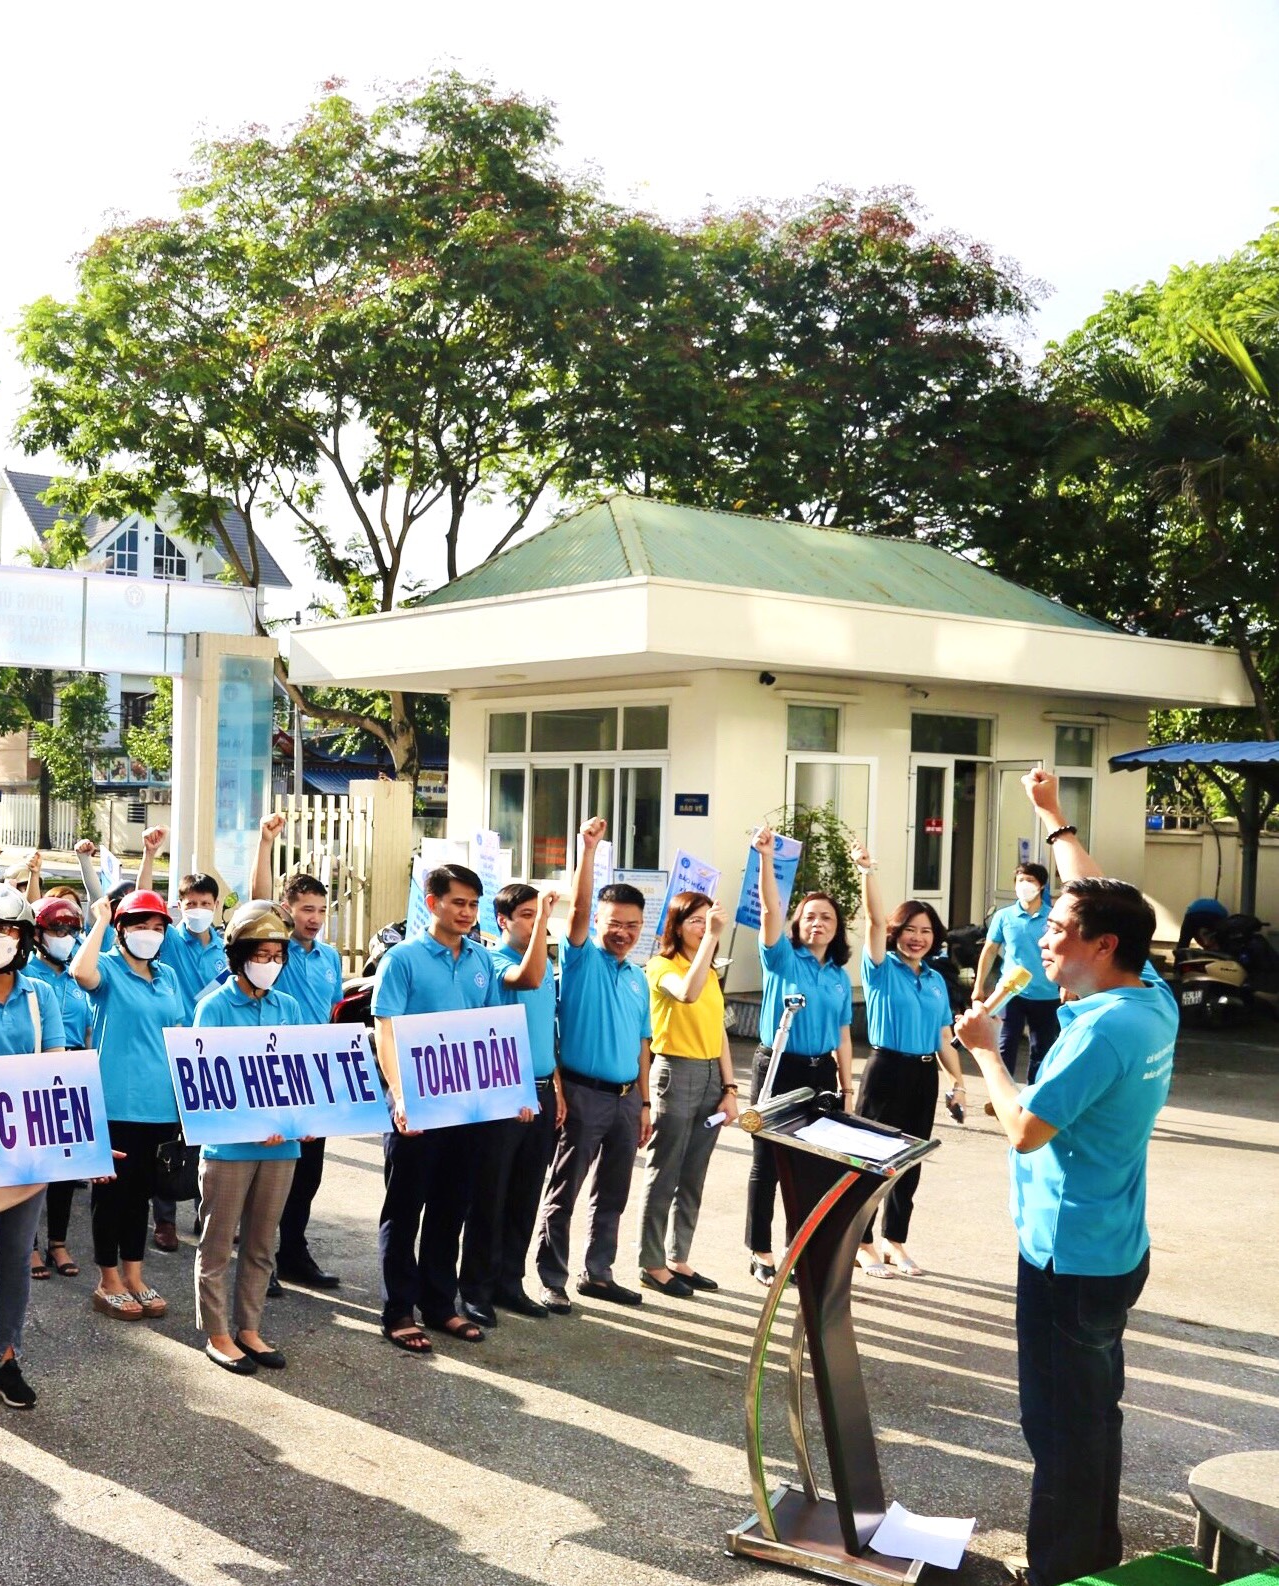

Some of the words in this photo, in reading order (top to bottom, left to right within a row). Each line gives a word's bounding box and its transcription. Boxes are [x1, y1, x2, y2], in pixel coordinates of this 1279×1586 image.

[176, 1038, 237, 1110] BẢO
[238, 1033, 315, 1108] HIỂM
[313, 1053, 335, 1104] Y
[336, 1034, 376, 1102] TẾ
[411, 1033, 471, 1097] TOÀN
[473, 1028, 521, 1089] DÂN
[23, 1076, 95, 1157] HIỆN
